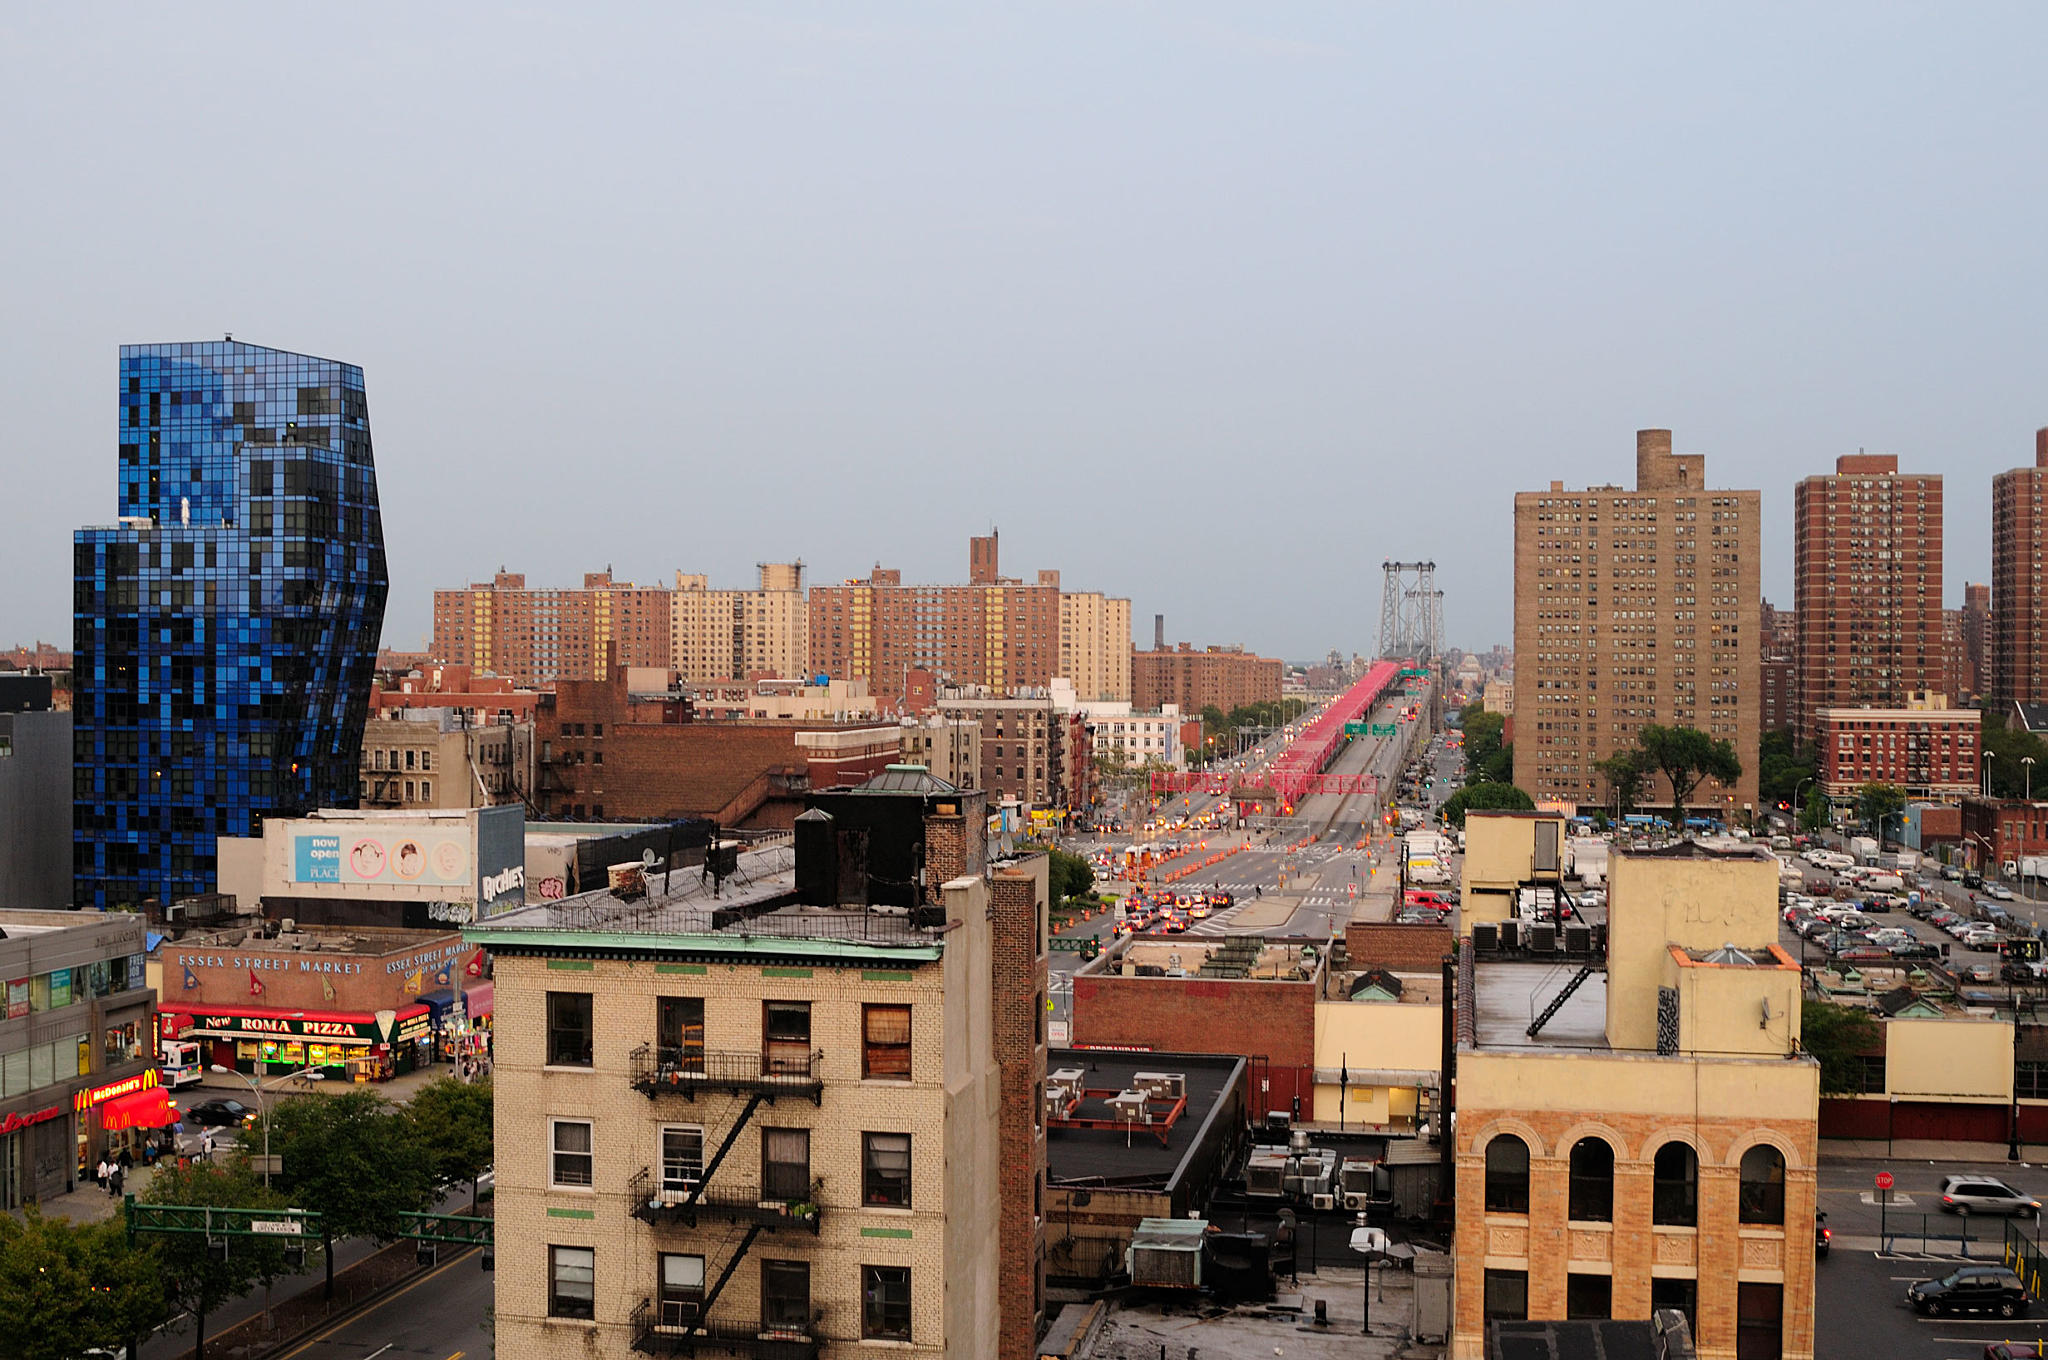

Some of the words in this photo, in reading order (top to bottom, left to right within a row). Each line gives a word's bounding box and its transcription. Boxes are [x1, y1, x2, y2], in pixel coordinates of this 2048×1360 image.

[313, 838, 337, 848] now
[310, 849, 340, 861] open
[179, 954, 225, 968] ESSEX
[234, 957, 291, 971] STREET
[300, 961, 362, 975] MARKET
[386, 957, 411, 974] ESSEX
[414, 949, 441, 966] STREET
[445, 941, 473, 957] MARKET
[240, 1018, 292, 1033] ROMA
[302, 1021, 357, 1037] PIZZA
[93, 1078, 140, 1102] McDonald's
[1876, 1176, 1892, 1184] STOP
